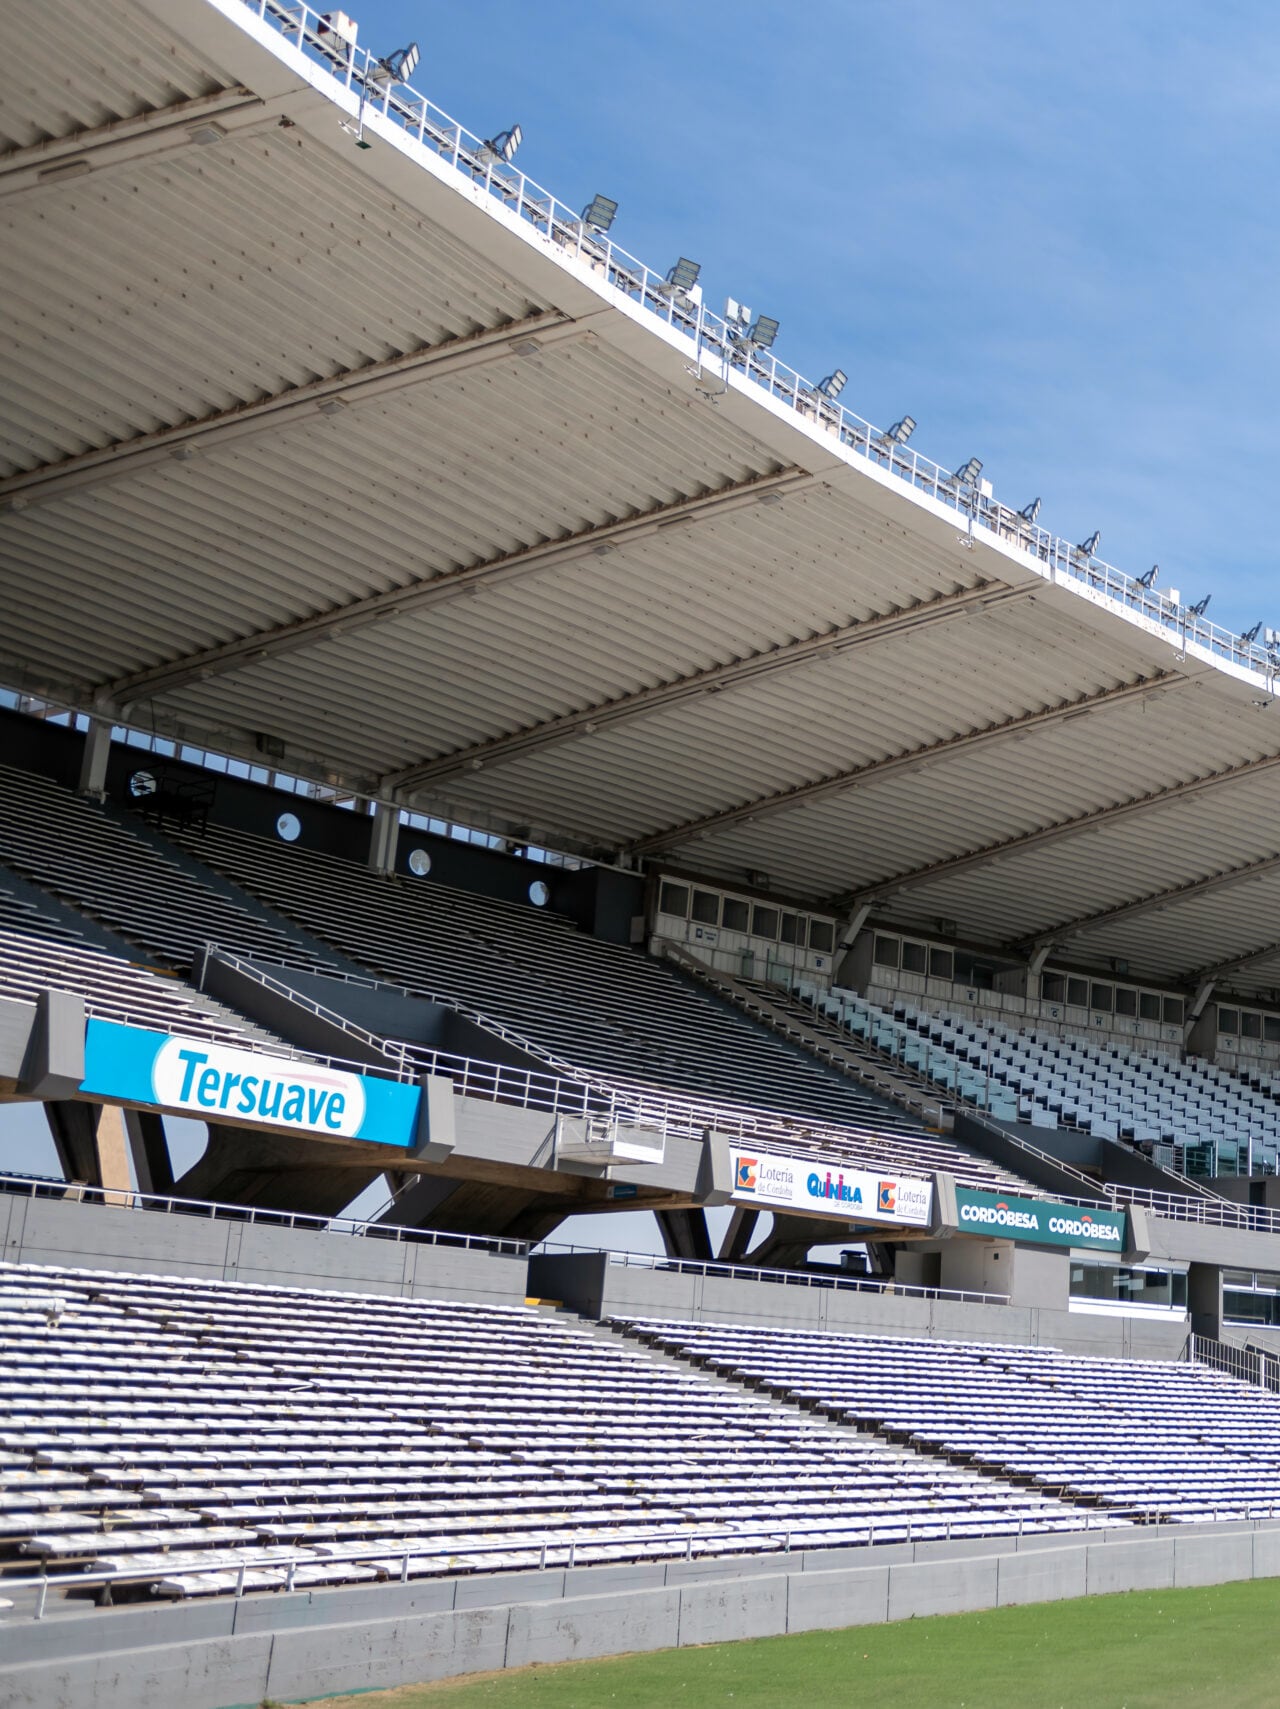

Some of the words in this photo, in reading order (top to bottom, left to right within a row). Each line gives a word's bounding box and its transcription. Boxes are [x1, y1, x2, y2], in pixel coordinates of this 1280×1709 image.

[178, 1049, 346, 1129] Tersuave
[961, 1205, 1039, 1230] CORDOBESA
[1049, 1217, 1120, 1241] CORDOBESA
